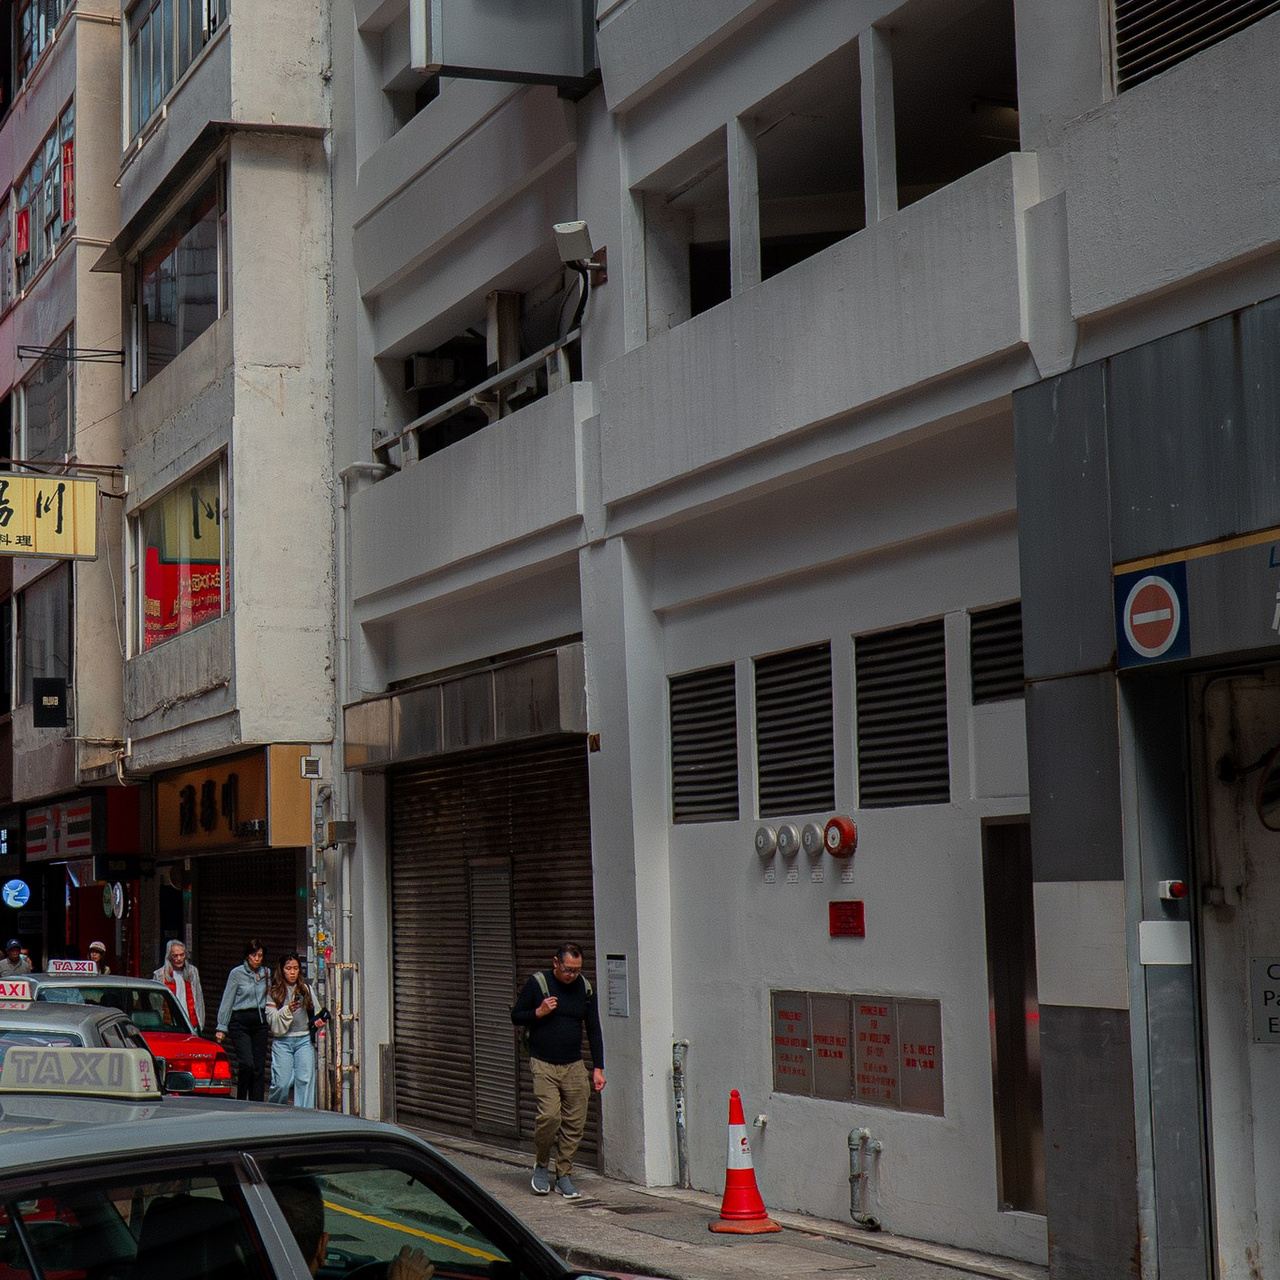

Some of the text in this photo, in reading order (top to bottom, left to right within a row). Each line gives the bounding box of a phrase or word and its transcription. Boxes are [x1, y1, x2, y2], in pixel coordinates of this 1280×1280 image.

[52, 960, 94, 971] TAXI
[11, 1051, 124, 1086] TAXI
[139, 1058, 151, 1090] 的士
